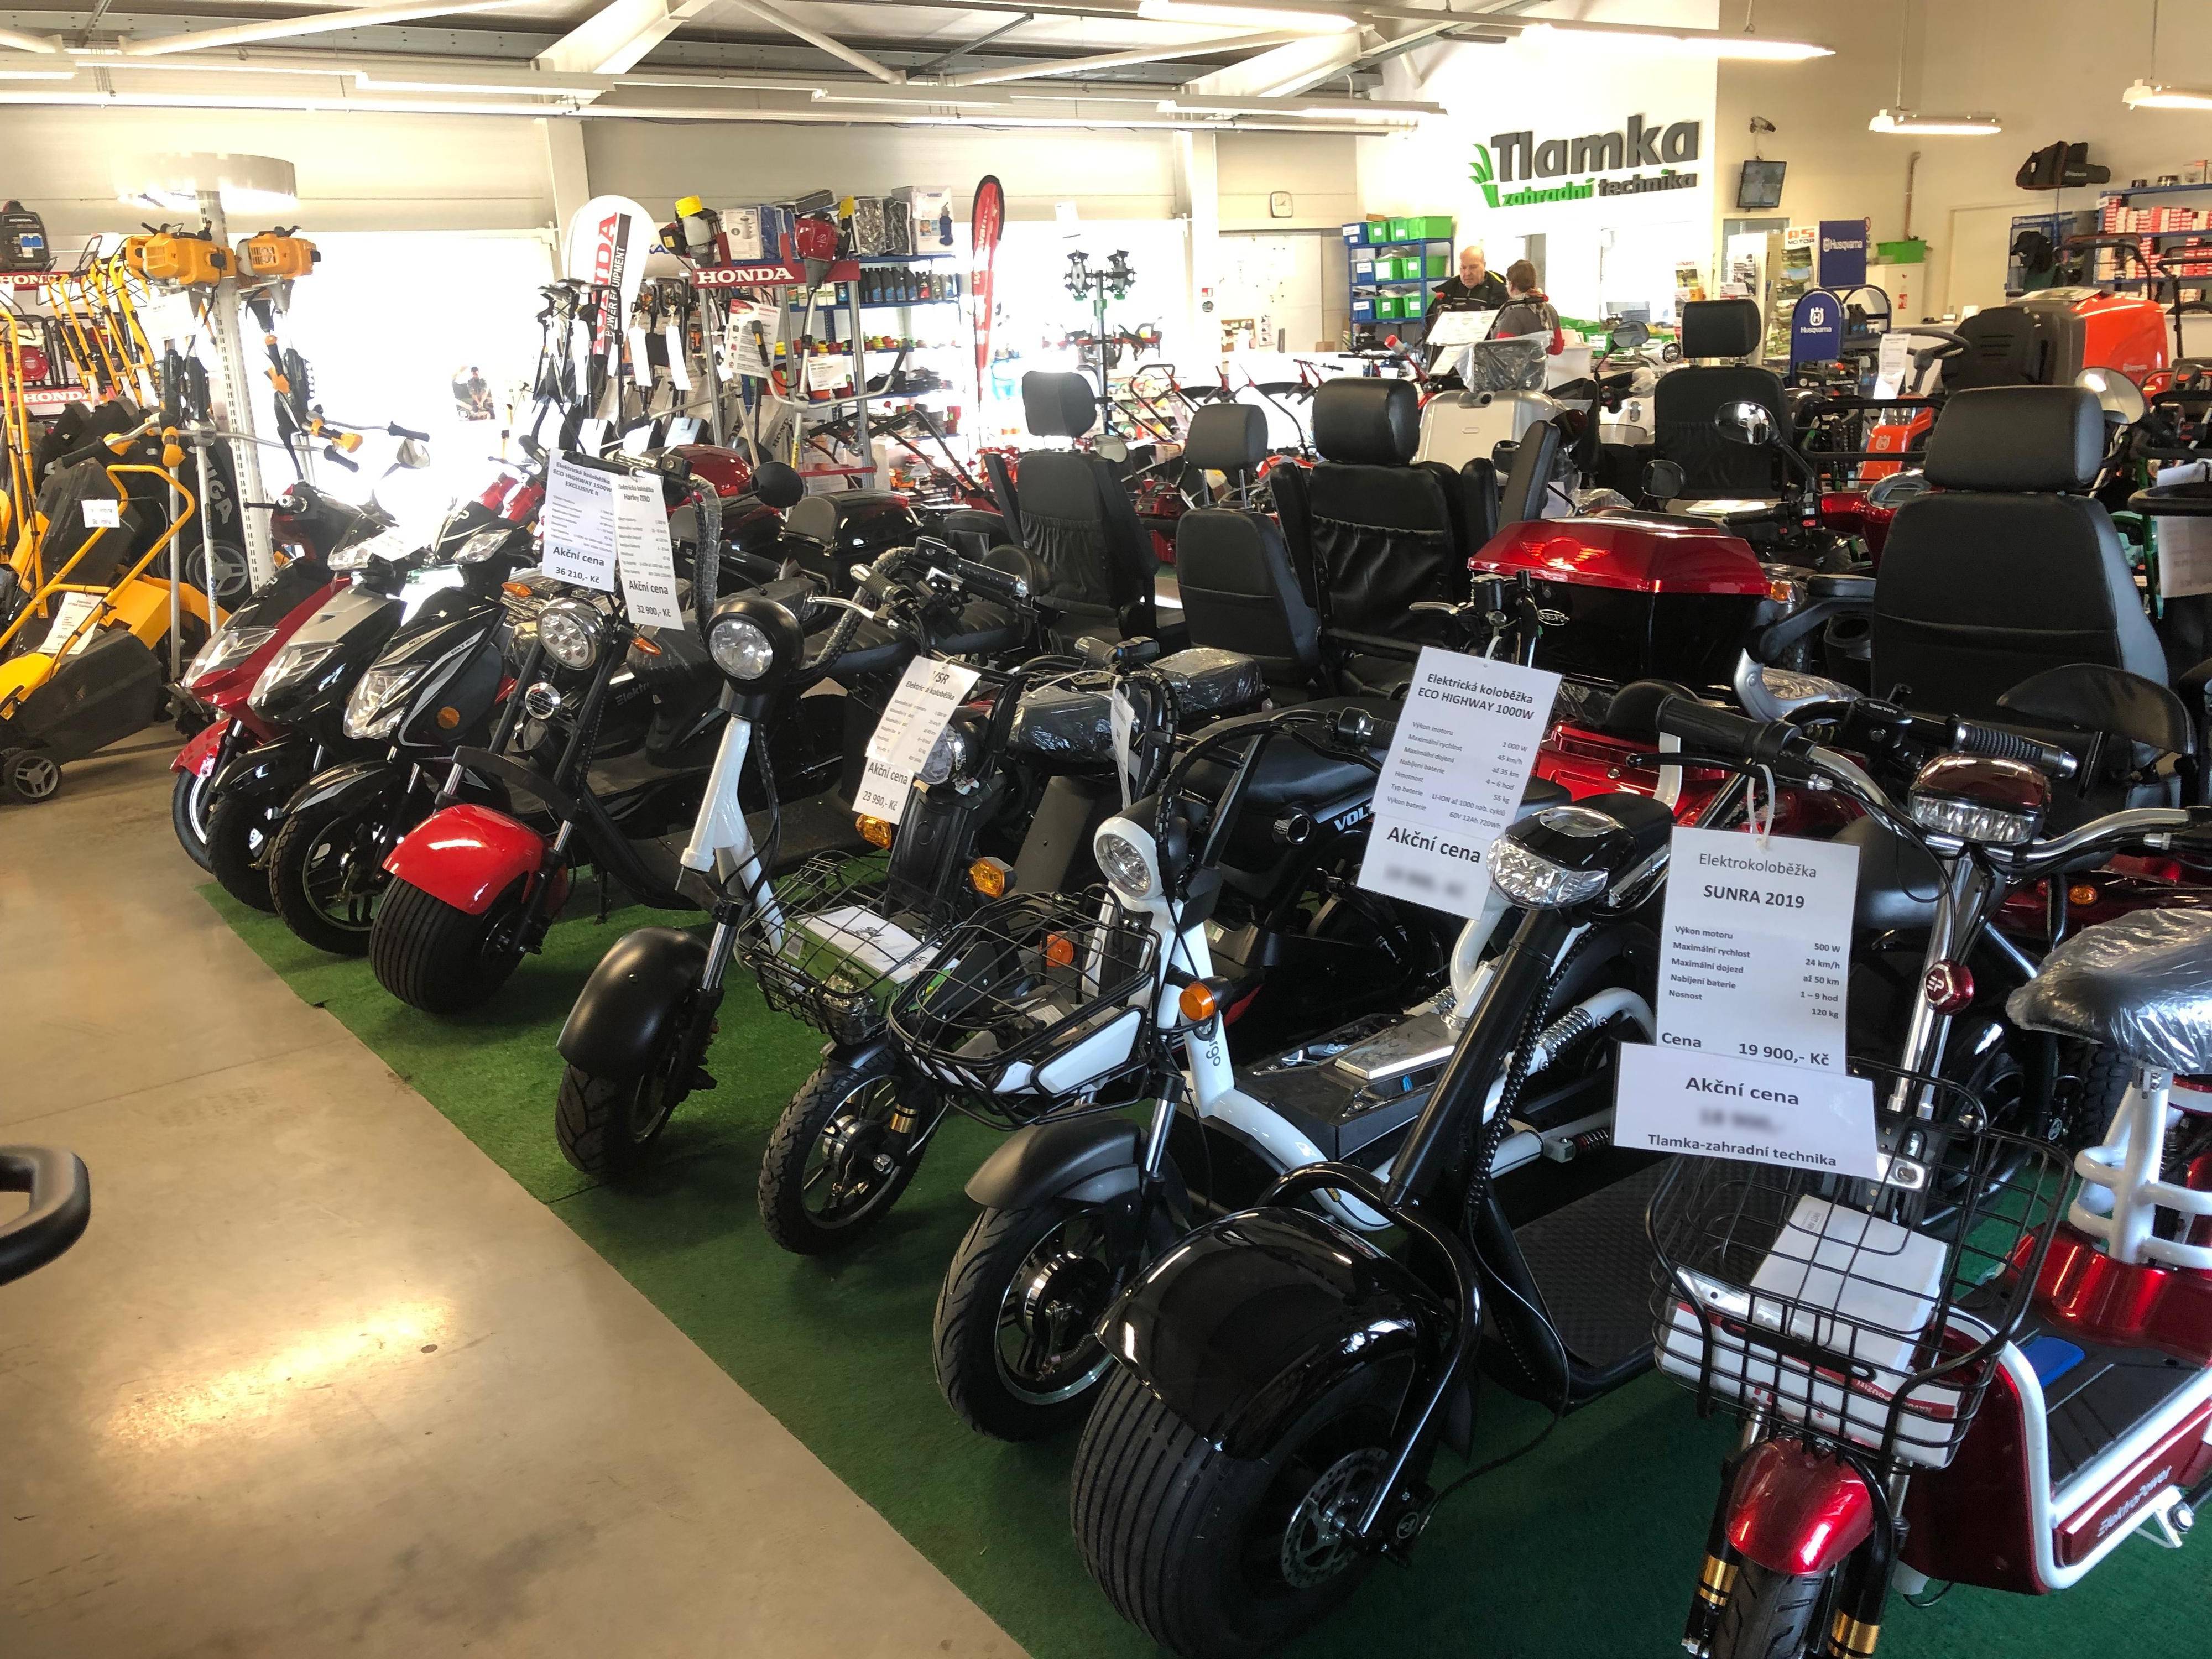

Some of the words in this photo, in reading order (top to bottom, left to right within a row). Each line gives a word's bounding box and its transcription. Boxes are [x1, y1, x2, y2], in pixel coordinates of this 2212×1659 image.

[1490, 113, 1700, 182] Tlamka
[1502, 178, 1595, 207] zahradní
[1598, 169, 1697, 197] technika
[1788, 228, 1815, 239] AS
[1830, 239, 1863, 251] Husqvarna
[0, 274, 66, 285] HON
[696, 267, 795, 284] HONDA
[23, 390, 90, 403] HOND
[565, 473, 592, 487] HIGHWAY
[553, 546, 581, 560] Akční
[582, 554, 604, 566] cena
[556, 567, 566, 575] 36
[590, 575, 600, 583] Kč
[629, 580, 649, 592] Akční
[651, 585, 669, 594] cena
[637, 604, 644, 613] 32
[663, 609, 671, 617] Kč
[906, 681, 930, 693] Elektricá
[1427, 674, 1478, 692] Elektrická
[1480, 684, 1533, 704] koloběžka
[1418, 687, 1439, 700] ECO
[1441, 692, 1494, 711] HIGHWAY
[1495, 704, 1535, 720] 1000W
[1412, 721, 1430, 731] Výkon
[1431, 727, 1454, 735] motoru
[1408, 734, 1438, 746] Maximální
[1439, 742, 1463, 752] rychlost
[1404, 747, 1435, 758] Maximální
[1434, 754, 1455, 763] dojezd
[1506, 756, 1523, 765] km/h
[868, 762, 891, 779] Akční
[890, 771, 908, 785] cena
[1395, 771, 1424, 782] Hmotnost
[1424, 764, 1446, 774] baterie
[1501, 782, 1515, 790] hod
[863, 791, 872, 801] 23
[888, 800, 898, 811] Kč
[1391, 783, 1401, 791] Typ
[1402, 786, 1423, 796] baterie
[1459, 800, 1475, 808] 1000
[1387, 796, 1405, 806] Výkon
[1406, 801, 1427, 811] baterie
[1387, 826, 1439, 852] Akční
[1440, 841, 1481, 864] cena
[1699, 853, 1817, 878] Elektrokoloběžka
[1703, 885, 1761, 904] SUNRA
[1765, 893, 1805, 909] 2019
[1675, 926, 1700, 935] Výkon
[1702, 930, 1733, 939] motoru
[1673, 942, 1717, 953] Maximální
[1718, 948, 1750, 958] rychlost
[1814, 943, 1829, 951] 500
[1671, 958, 1715, 969] Maximální
[1717, 964, 1744, 973] dojezd
[1818, 960, 1840, 969] km/h
[1671, 974, 1705, 984] Nabíjení
[1706, 979, 1736, 989] baterie
[1669, 990, 1702, 1000] Nosnost
[1822, 993, 1838, 1002] hod
[1829, 1010, 1839, 1019] kg
[1661, 1032, 1702, 1048] Cena
[1739, 1043, 1758, 1056] 19
[1763, 1046, 1805, 1063] 900,-
[1810, 1052, 1829, 1066] Kč
[1686, 1077, 1745, 1097] Akční
[1750, 1088, 1799, 1105] cena
[1648, 1134, 1769, 1157] Tlamka-zahradní
[1773, 1148, 1837, 1166] technika
